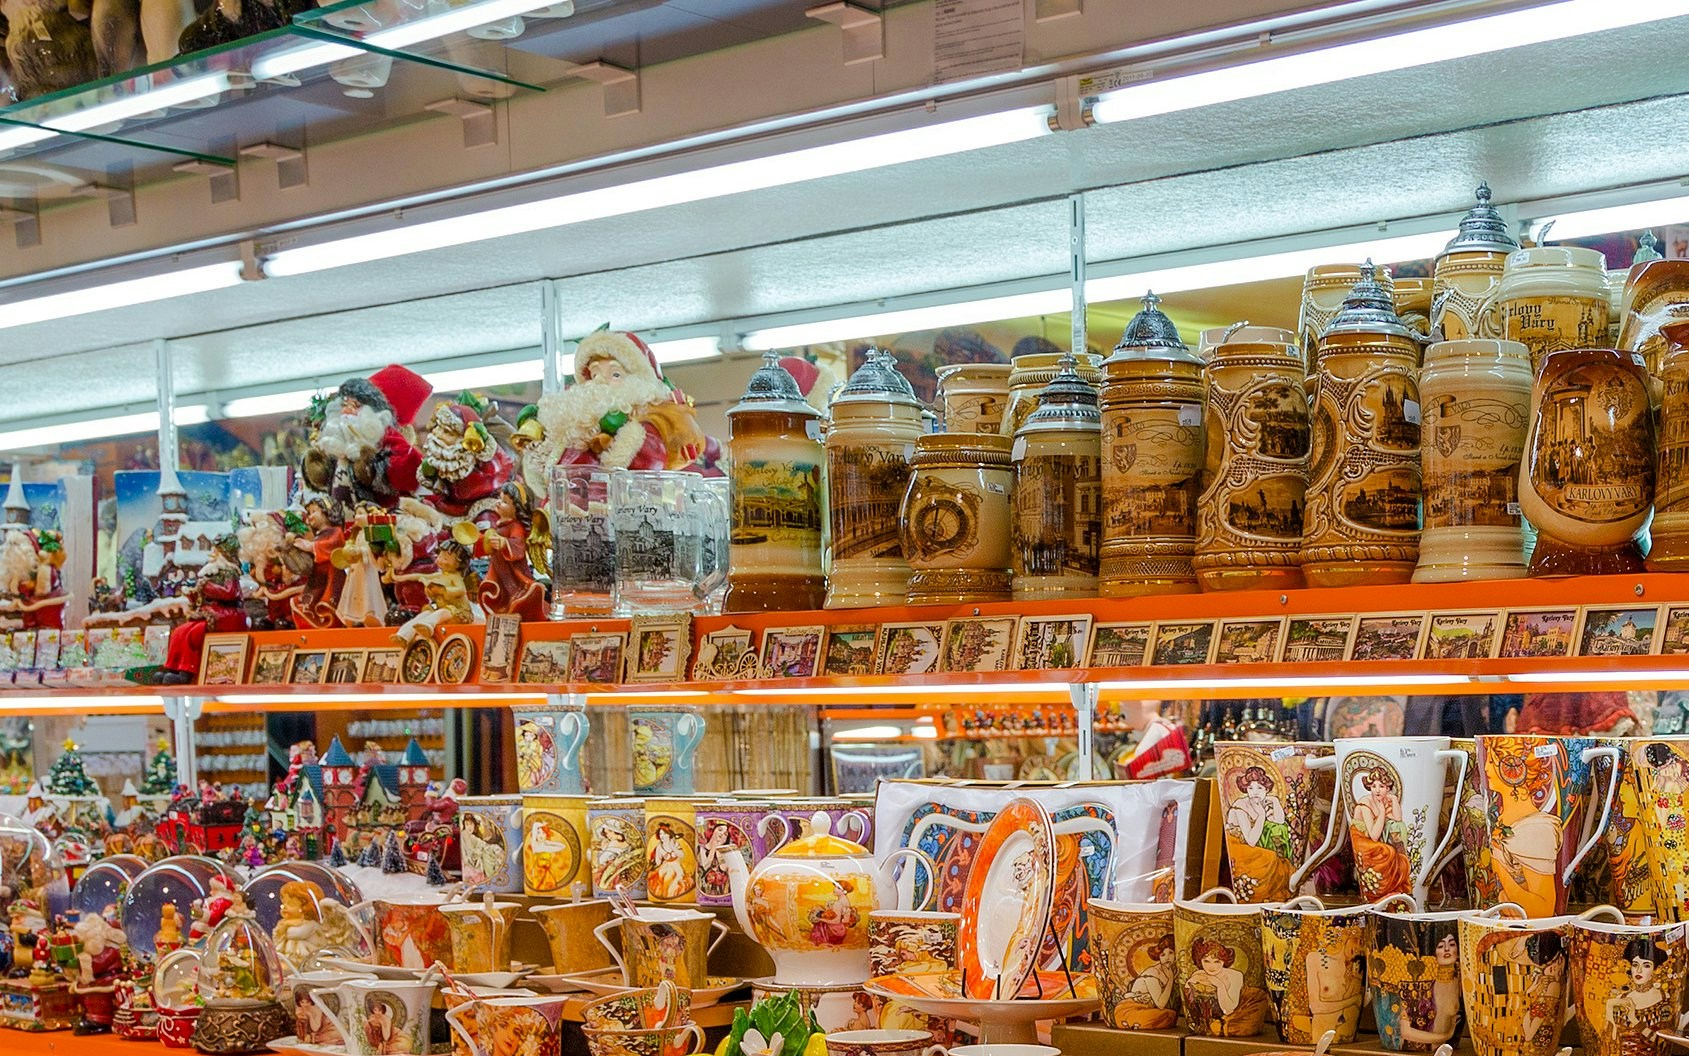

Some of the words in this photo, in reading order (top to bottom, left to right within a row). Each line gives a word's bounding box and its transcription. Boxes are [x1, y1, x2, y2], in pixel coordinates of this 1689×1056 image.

[1519, 315, 1556, 332] Vary
[1569, 487, 1613, 501] KARLOVY
[1613, 485, 1638, 499] VARY
[639, 503, 658, 516] Vary
